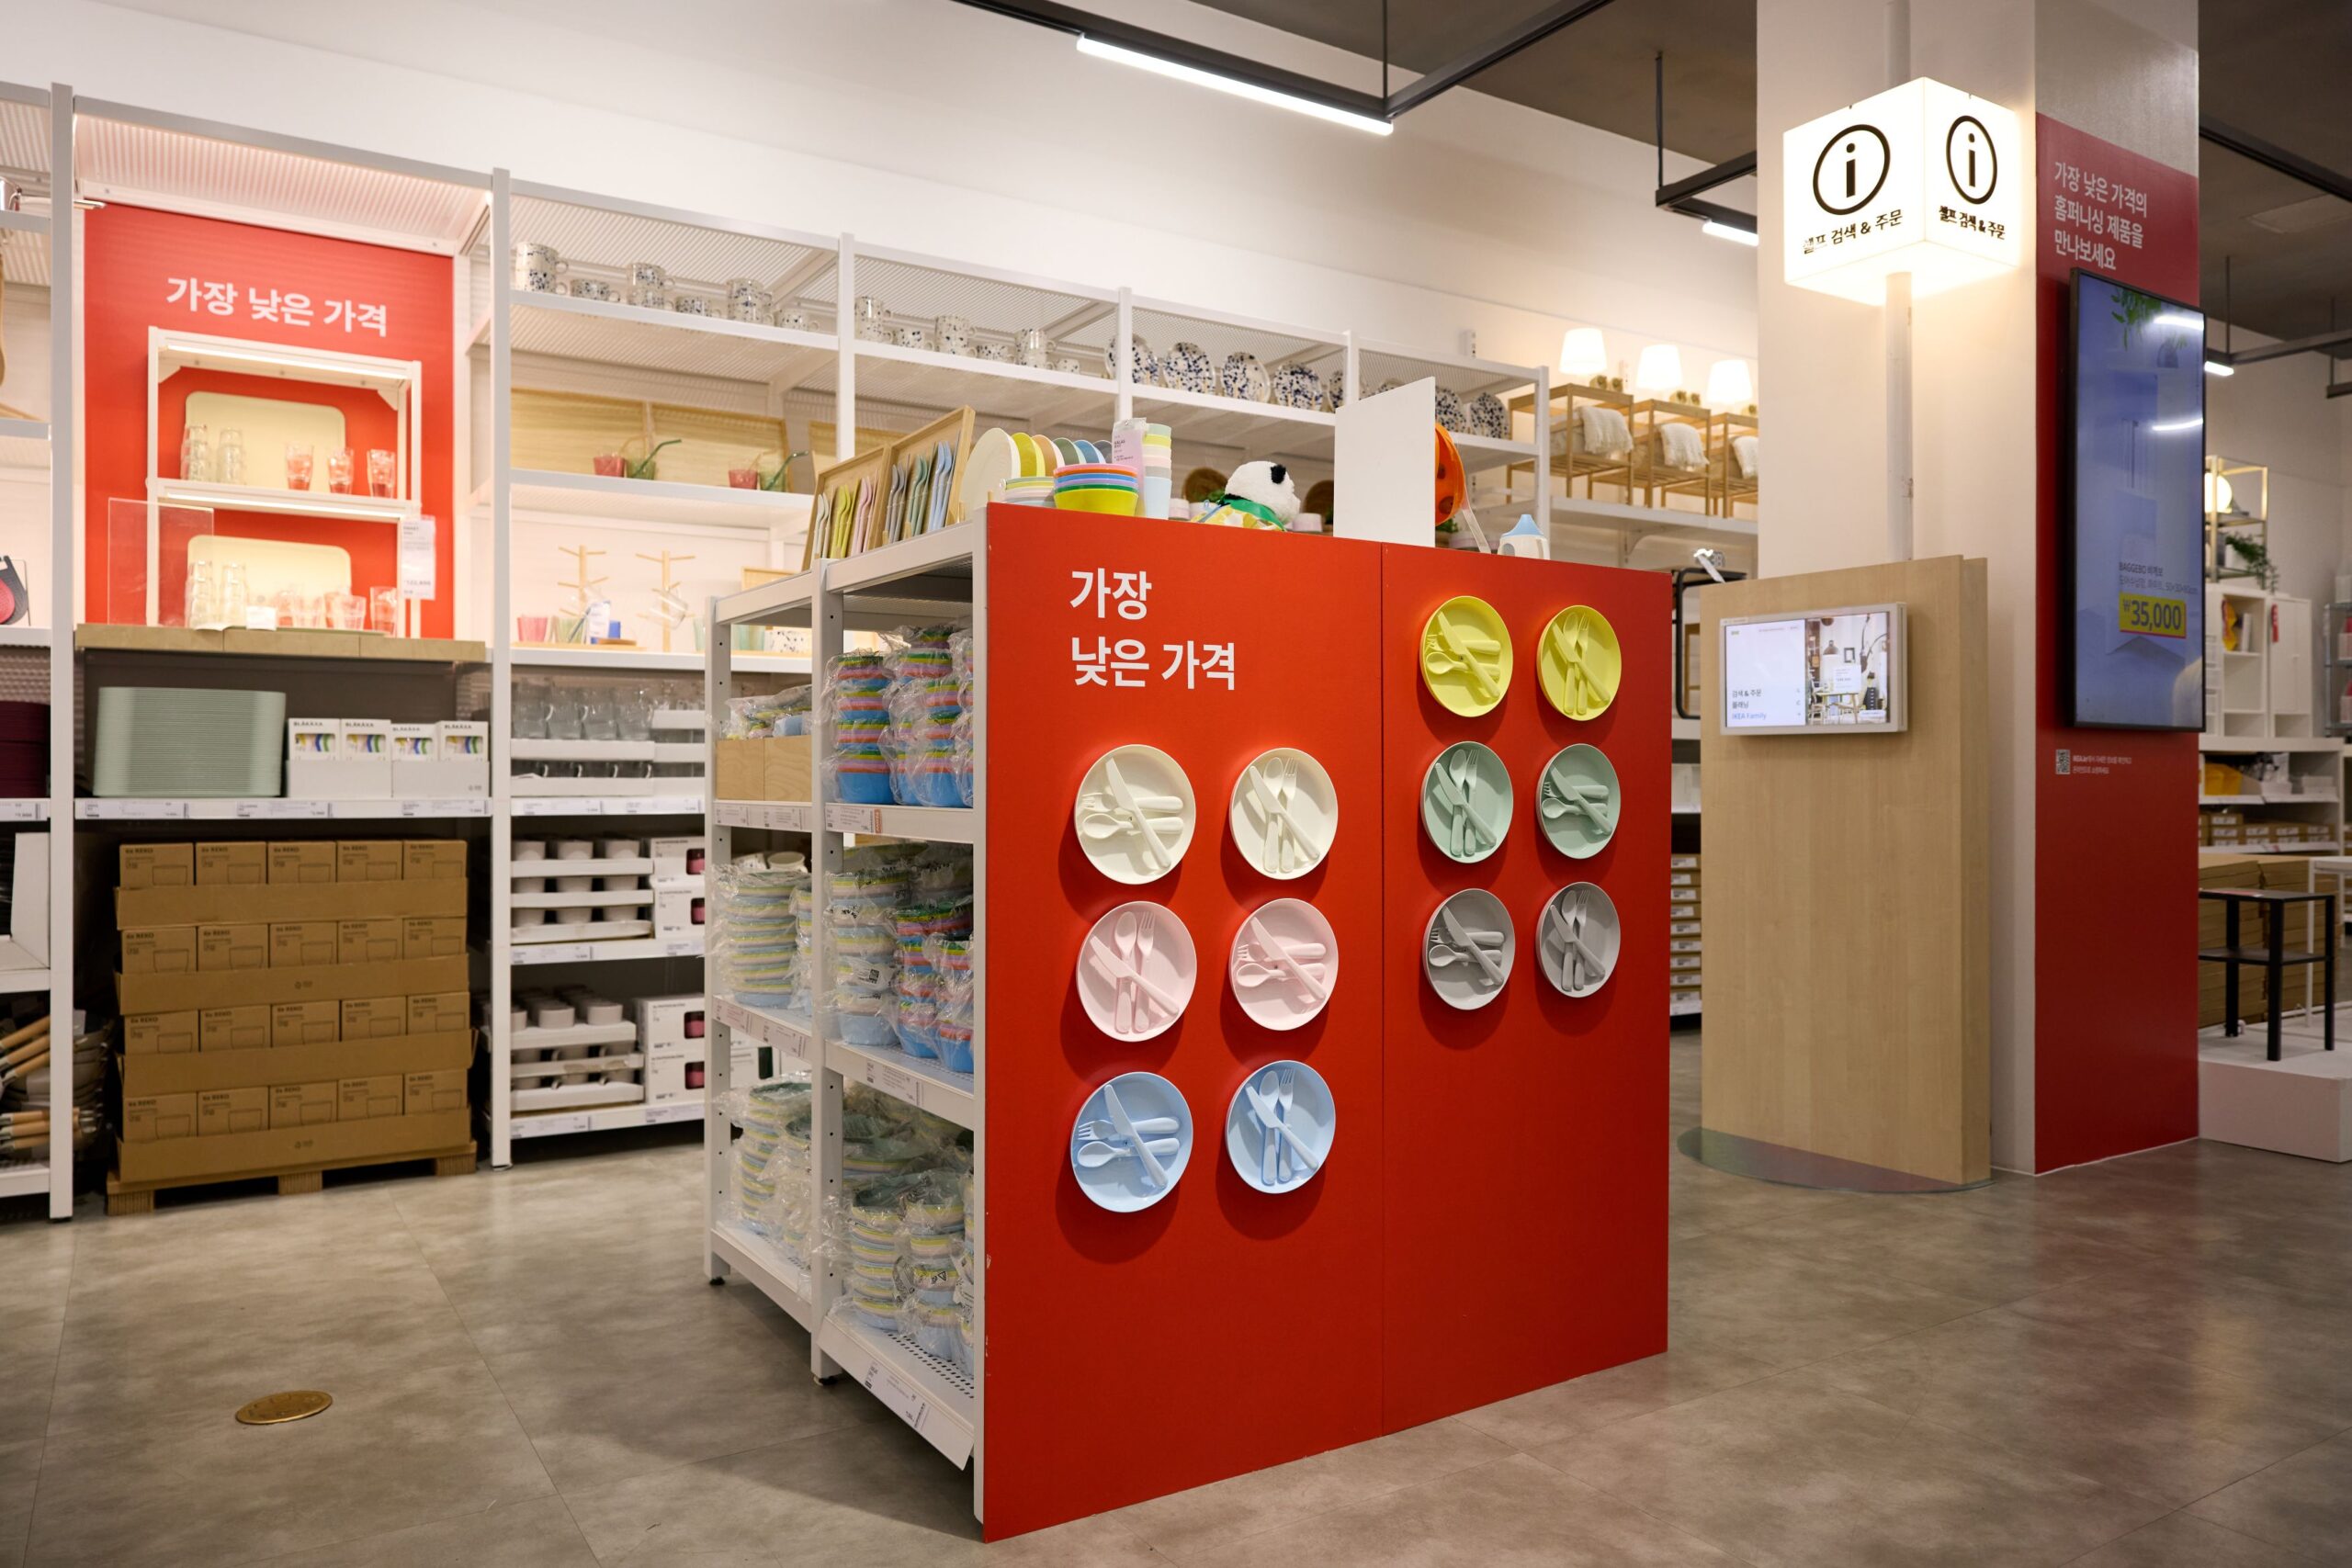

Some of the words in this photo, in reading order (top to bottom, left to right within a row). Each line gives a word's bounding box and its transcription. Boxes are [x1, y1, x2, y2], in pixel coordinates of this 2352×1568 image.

[2054, 162, 2080, 193] 가장
[2084, 171, 2109, 204] 낮은
[2111, 184, 2147, 219] 가격의
[1830, 223, 1857, 245] 검색
[1860, 221, 1871, 234] &
[1874, 209, 1903, 231] 주문
[1959, 212, 1977, 231] 검색
[1978, 220, 1986, 233] &
[1987, 220, 2006, 241] 주문
[2054, 194, 2104, 235] 홈퍼니싱
[2107, 215, 2143, 249] 제품을
[2054, 229, 2117, 270] 만나보세요
[166, 276, 239, 316] 가장
[248, 287, 314, 327] 낮은
[323, 299, 387, 338] 가격
[1069, 568, 1152, 620] 가장
[1071, 636, 1150, 688] 낮은
[1161, 640, 1235, 691] 가격
[1747, 712, 1767, 721] Family
